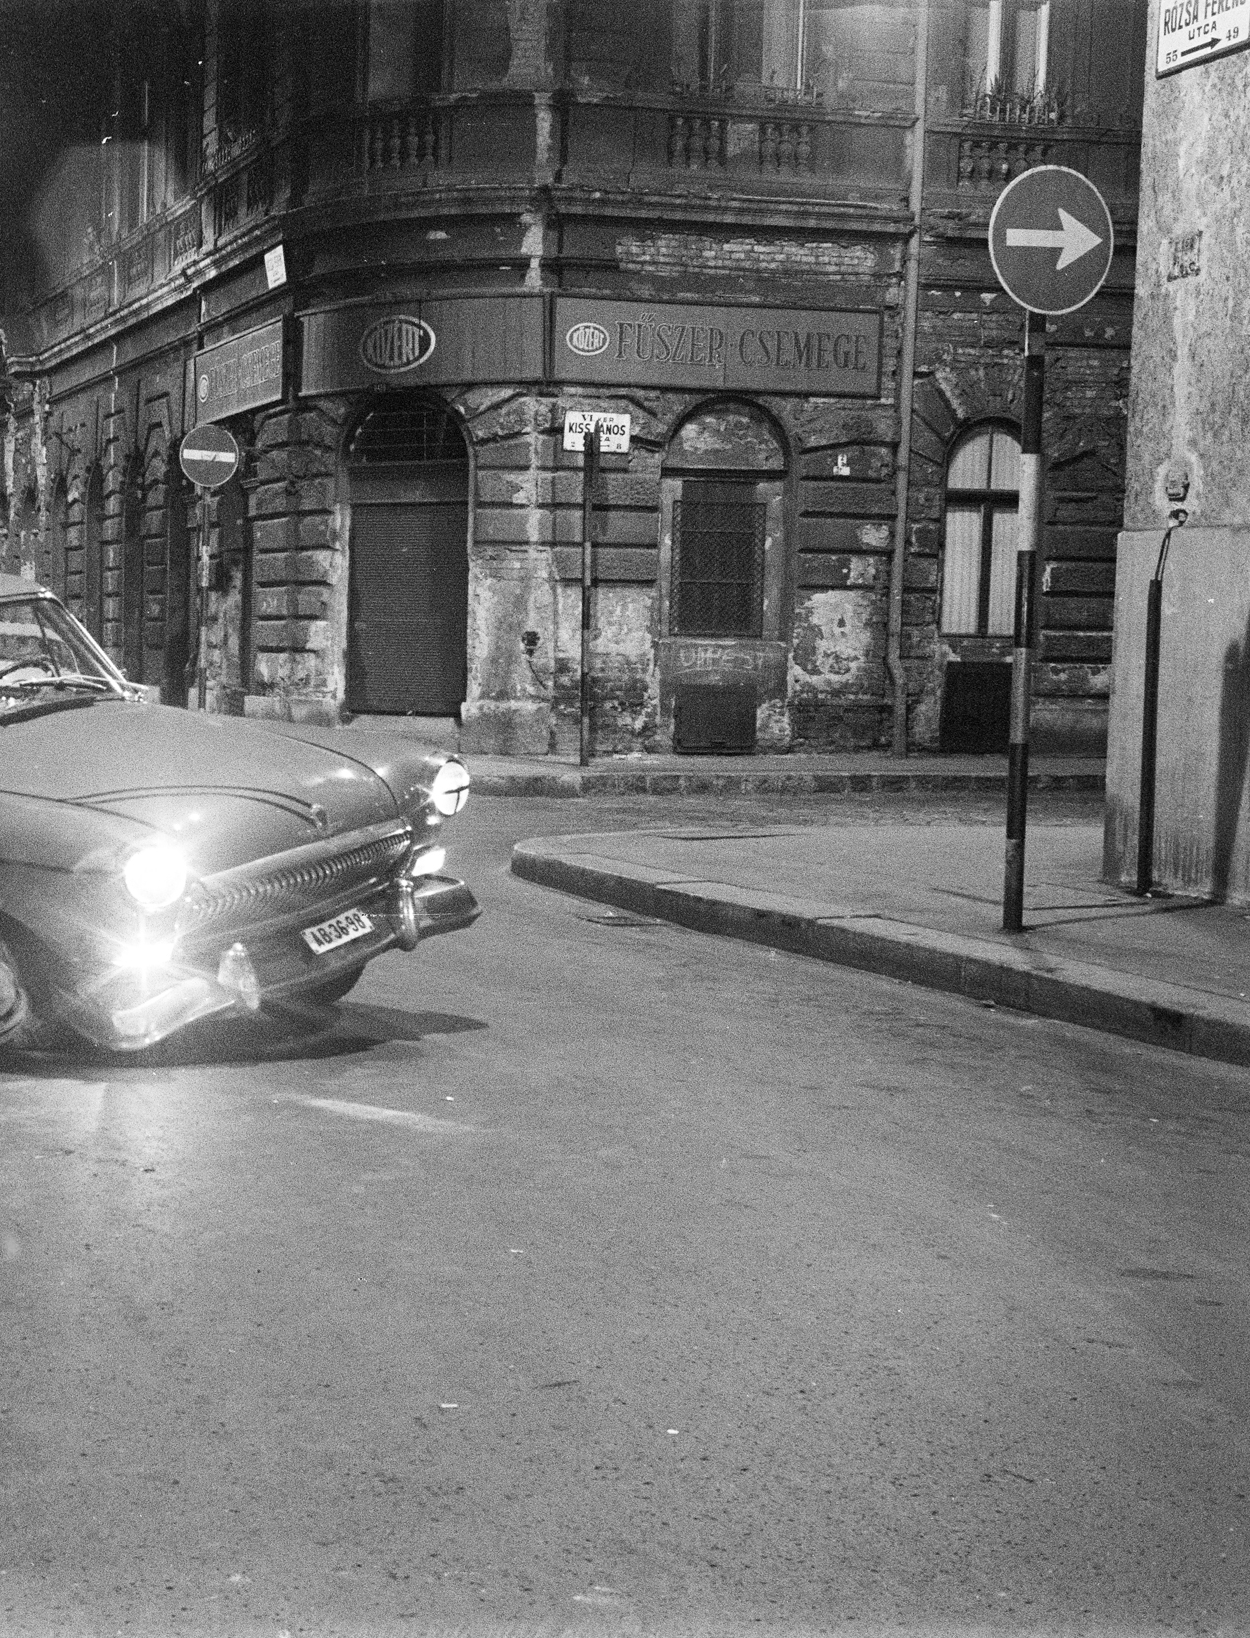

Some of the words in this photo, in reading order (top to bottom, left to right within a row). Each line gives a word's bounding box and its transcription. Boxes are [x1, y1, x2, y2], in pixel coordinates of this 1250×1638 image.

[1188, 20, 1217, 40] UTCA
[1165, 49, 1178, 64] 55
[1226, 26, 1240, 41] 49
[614, 313, 726, 365] FŰSZER
[738, 329, 869, 371] CSEMEGE
[568, 422, 591, 434] KISS
